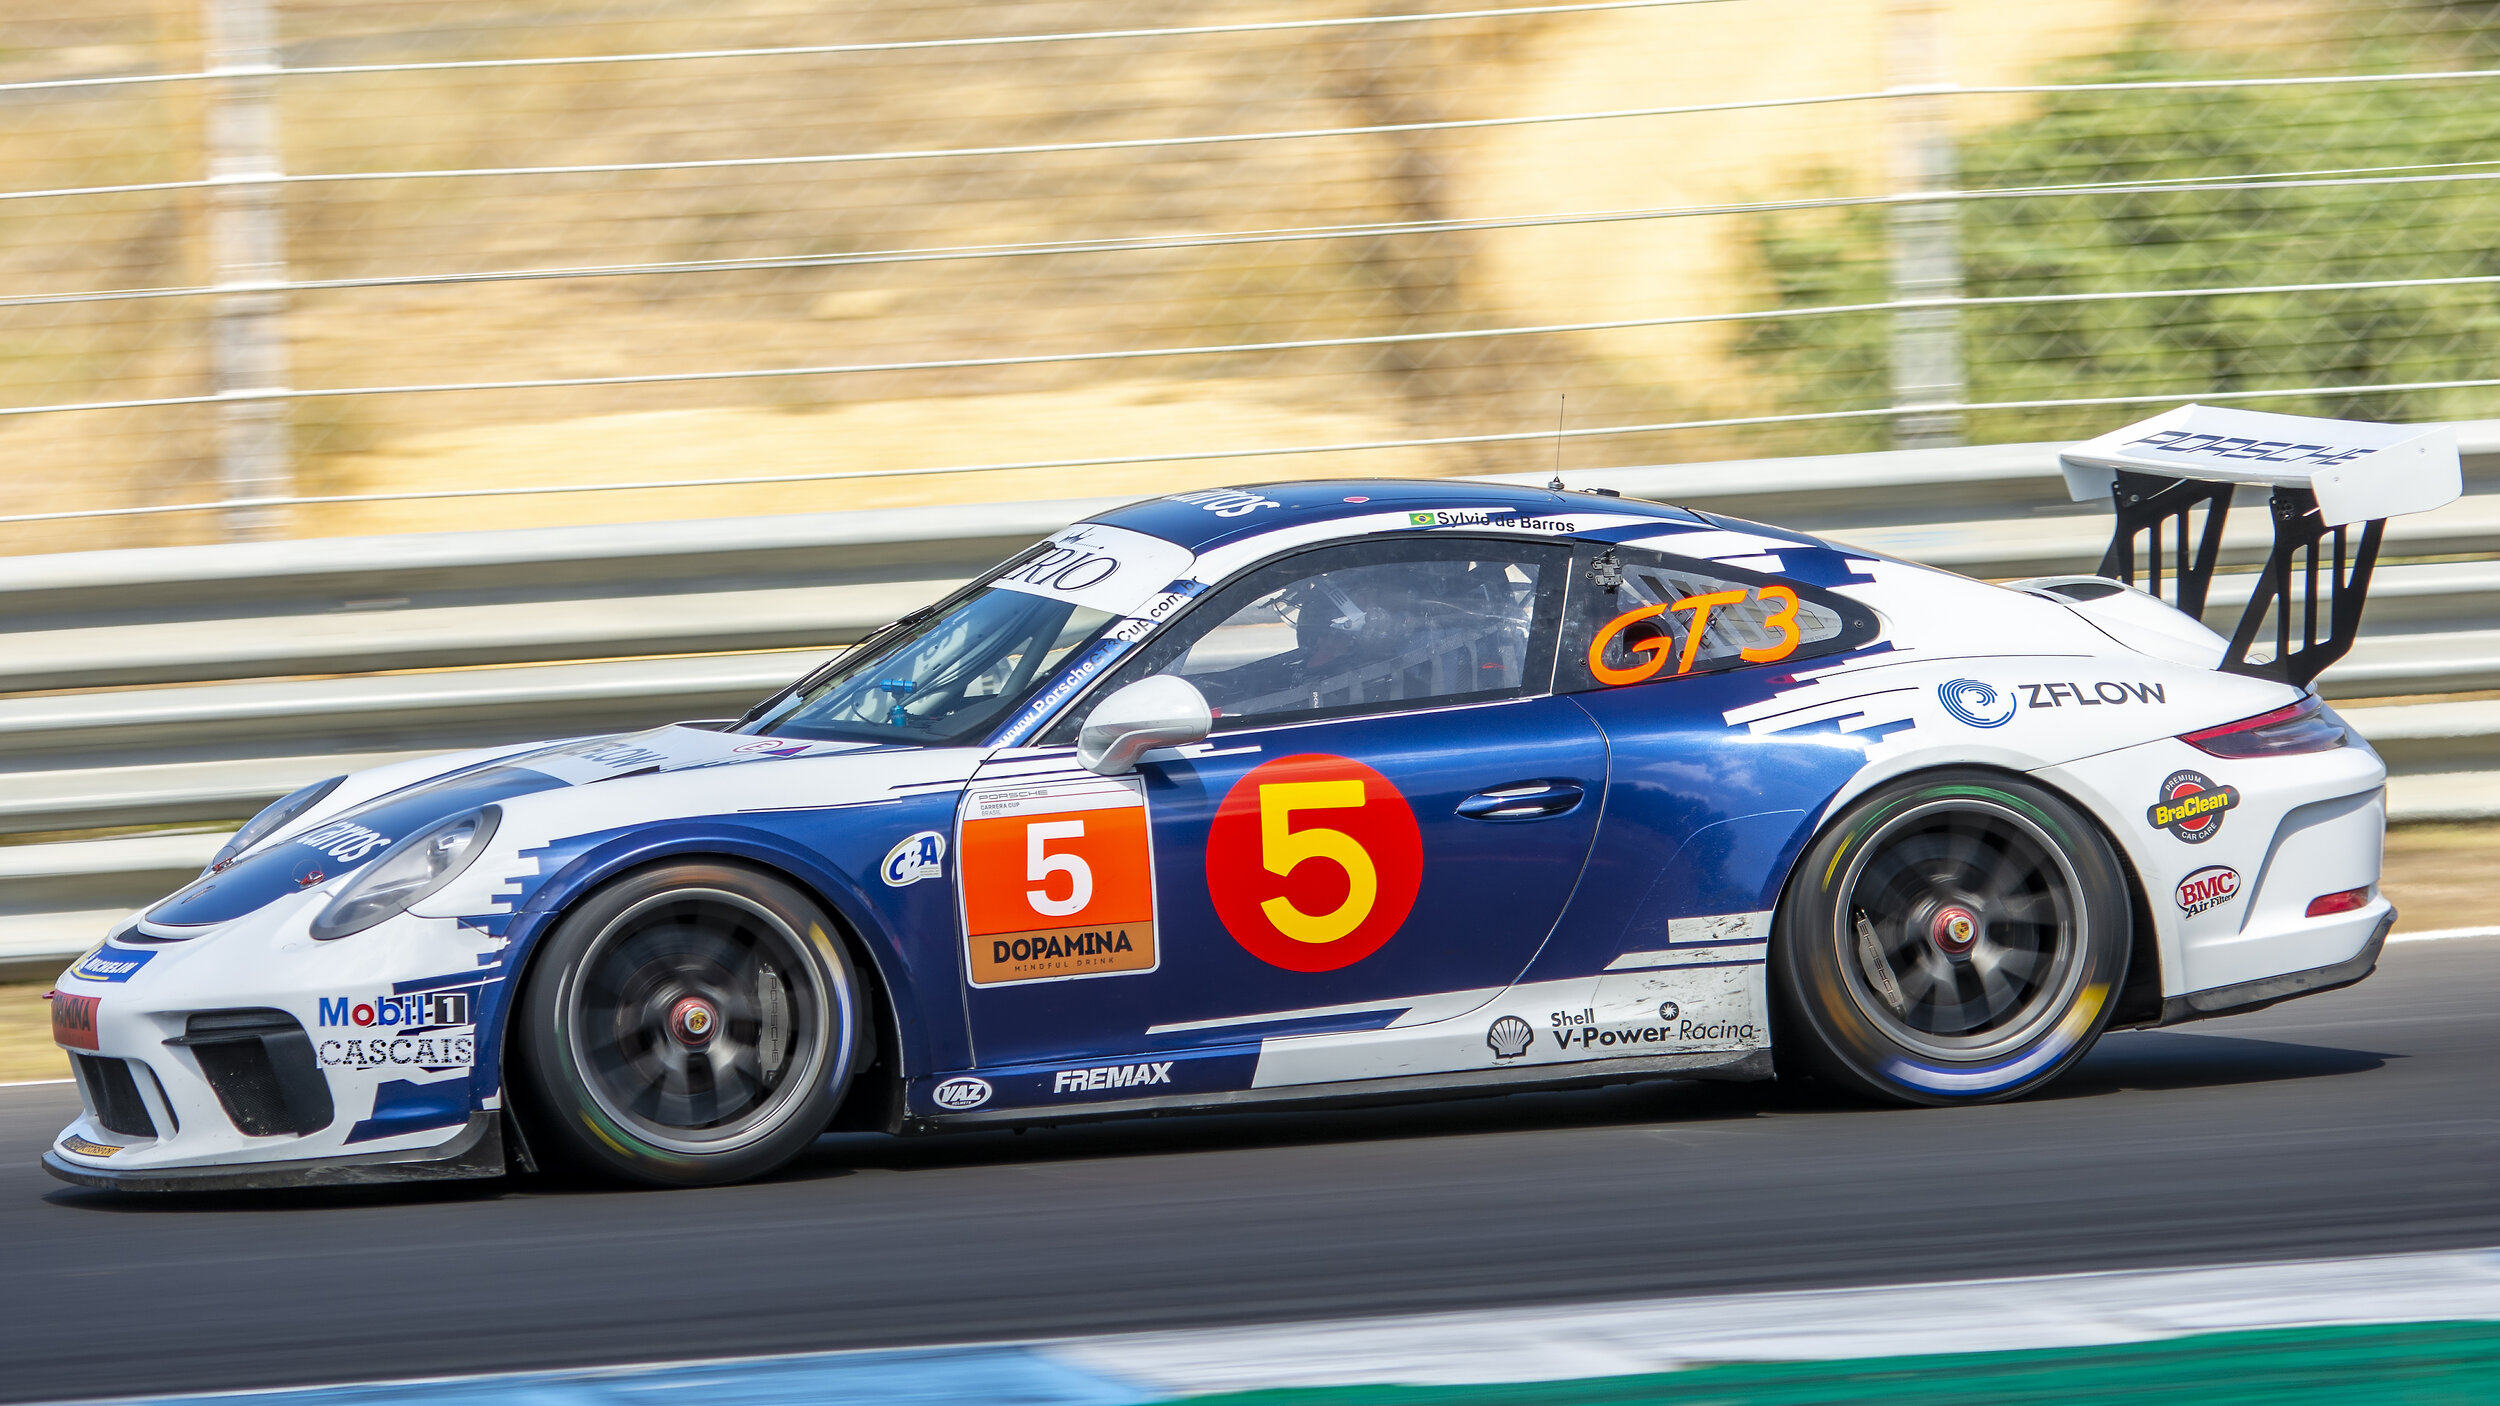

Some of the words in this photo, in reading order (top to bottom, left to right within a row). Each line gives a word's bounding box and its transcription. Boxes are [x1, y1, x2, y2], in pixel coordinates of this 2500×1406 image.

[2122, 430, 2380, 466] PORSCHE
[1437, 511, 1491, 528] Sylvio
[1495, 514, 1516, 528] de
[1521, 515, 1575, 532] Barros
[1000, 546, 1121, 592] RIO
[2017, 681, 2166, 709] ZFLOW
[978, 789, 1049, 801] PORSCHE
[2165, 774, 2202, 792] PREMIUM
[980, 802, 1007, 811] CARRERA
[1008, 801, 1021, 809] CUP
[2156, 793, 2229, 825] BraClean
[2181, 831, 2198, 840] CAR
[2199, 822, 2217, 839] CARE
[889, 836, 939, 881] CBA
[1026, 820, 1093, 917] 5
[1260, 779, 1377, 944] 5
[2181, 872, 2235, 907] BMC
[2185, 901, 2209, 919] Air
[2210, 894, 2233, 909] Filter
[993, 929, 1133, 964] DOPAMINA
[83, 957, 139, 974] MICHELIN
[1014, 961, 1069, 972] MINDFUL
[1077, 957, 1115, 967] DRINK
[319, 996, 425, 1027] Mobil
[769, 977, 779, 1064] PORSCHE
[1550, 1007, 1595, 1028] Shell
[319, 1038, 473, 1066] CASCAIS
[1552, 1026, 1671, 1050] V-Power
[1053, 1061, 1174, 1094] FREMAX
[940, 1084, 984, 1103] VAZ
